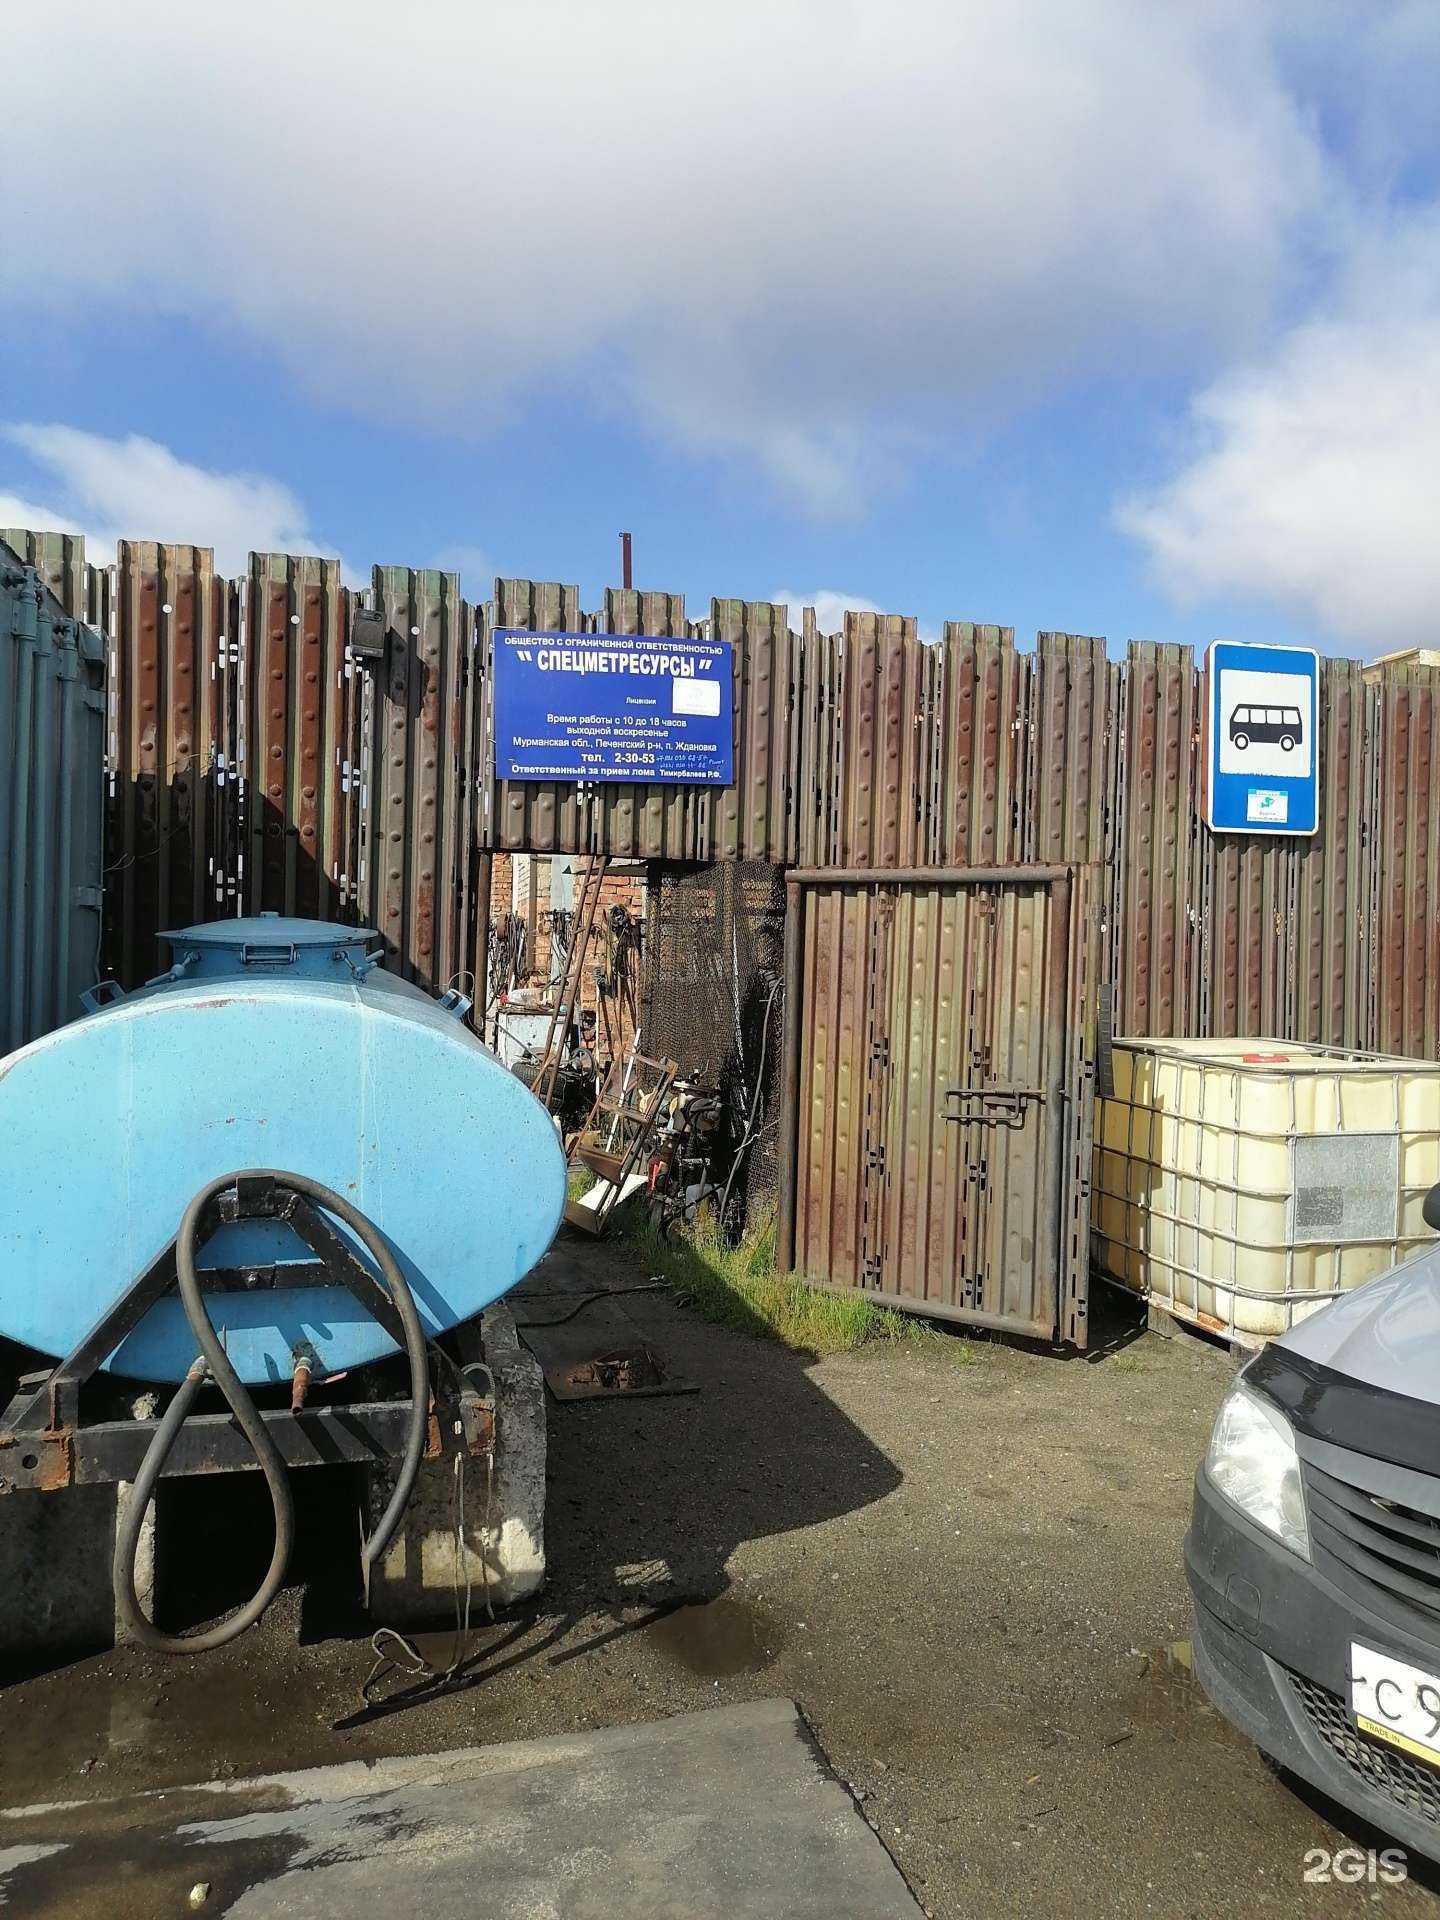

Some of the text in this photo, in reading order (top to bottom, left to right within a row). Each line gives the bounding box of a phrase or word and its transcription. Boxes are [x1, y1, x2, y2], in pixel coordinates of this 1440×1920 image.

[505, 637, 555, 646] ОБЩЕСТВО
[565, 639, 634, 649] ОГРАНИЧЕННОЙ
[636, 641, 723, 655] ОТВЕТСТВЕННОСТЬЮ
[547, 713, 577, 724] Время
[580, 715, 613, 725] работы
[623, 716, 634, 725] 10
[635, 718, 647, 726] до
[649, 717, 660, 726] 18
[661, 719, 687, 727] часов
[567, 727, 669, 737] выходной воскресенье
[513, 737, 569, 747] Мурманская
[595, 738, 646, 750] Печенгский
[675, 741, 717, 752] Ждановка
[581, 753, 605, 762] тел.
[614, 752, 655, 764] 2-30-53
[511, 764, 586, 775] Ответственный
[588, 767, 599, 775] за
[601, 767, 630, 777] прием
